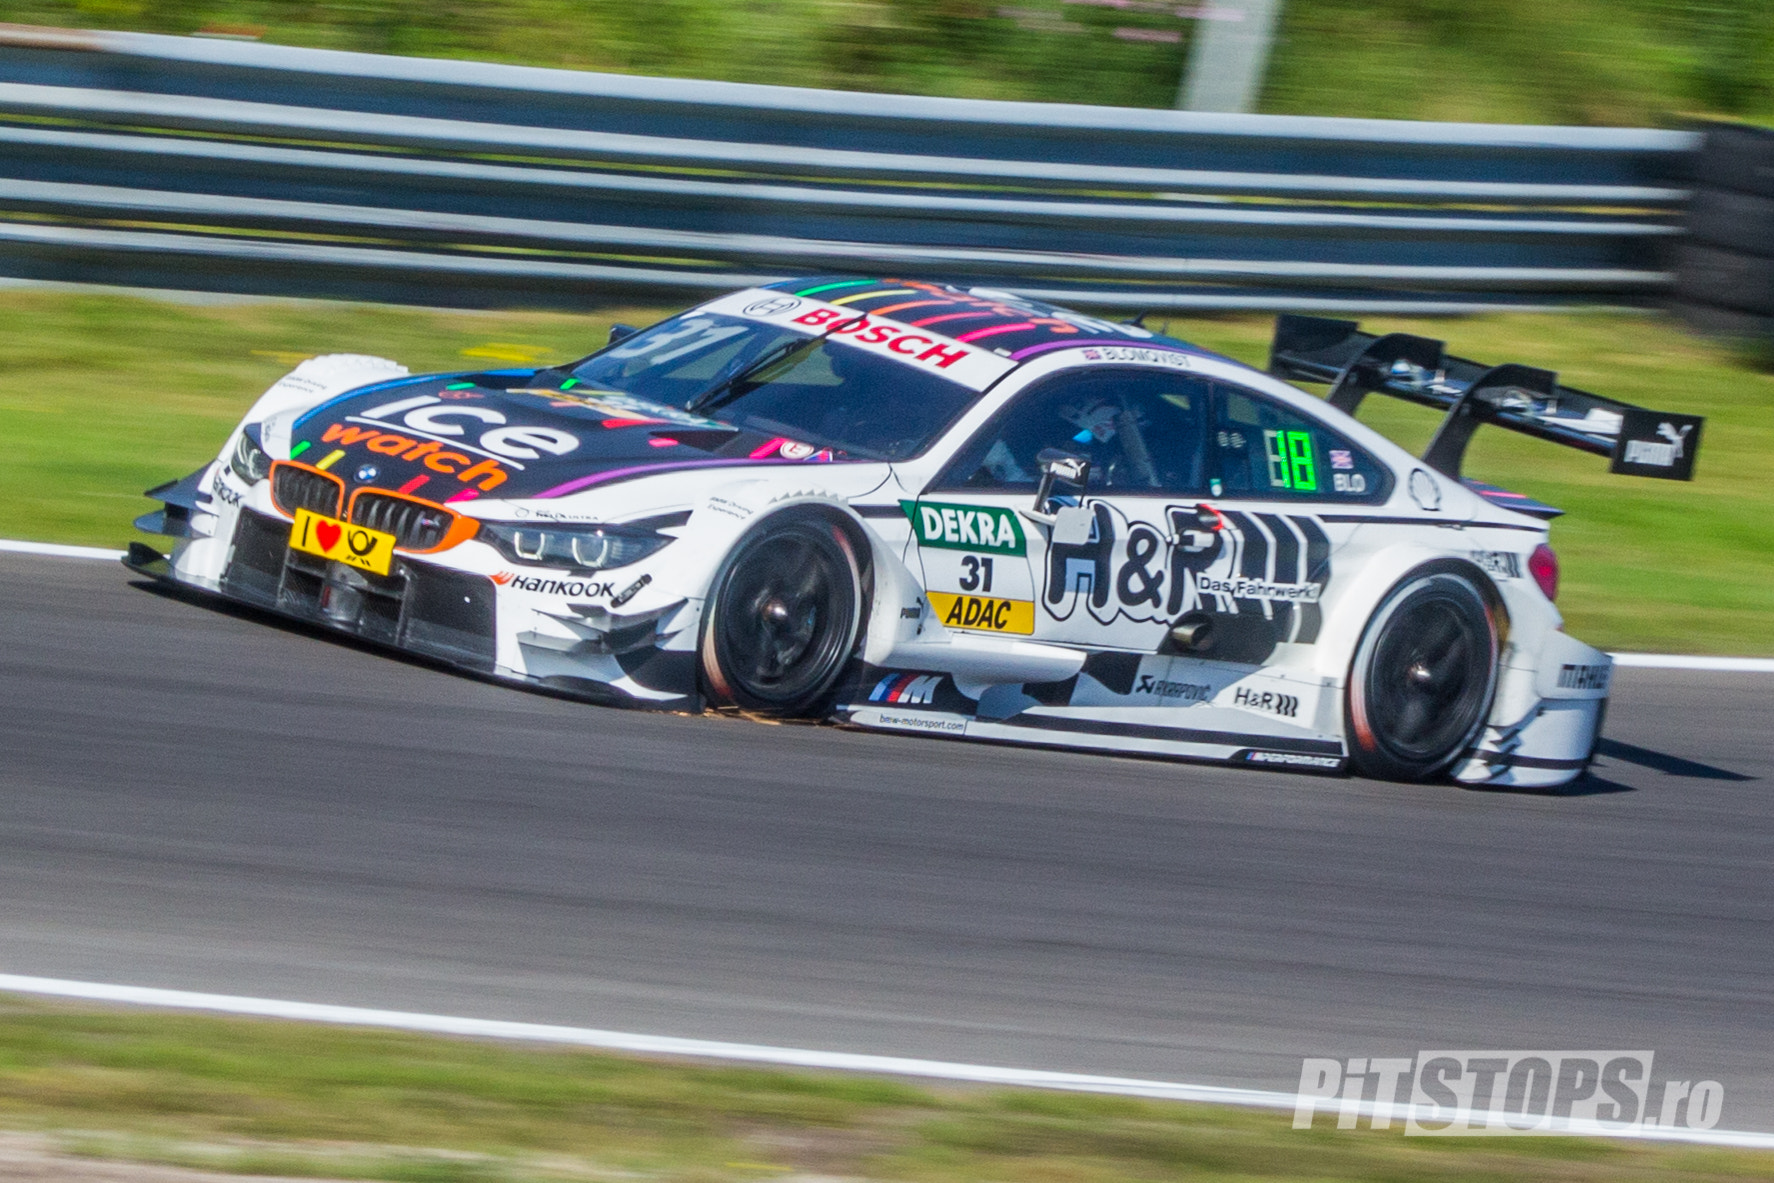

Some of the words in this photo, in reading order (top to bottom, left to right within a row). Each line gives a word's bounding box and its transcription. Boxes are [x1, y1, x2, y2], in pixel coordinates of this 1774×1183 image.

[791, 308, 970, 369] BOSCH
[321, 423, 508, 492] watch
[920, 506, 1017, 550] DEKRA
[958, 555, 995, 593] 31
[1200, 576, 1230, 593] Das
[945, 596, 1012, 630] ADAC
[1234, 686, 1273, 710] H&R
